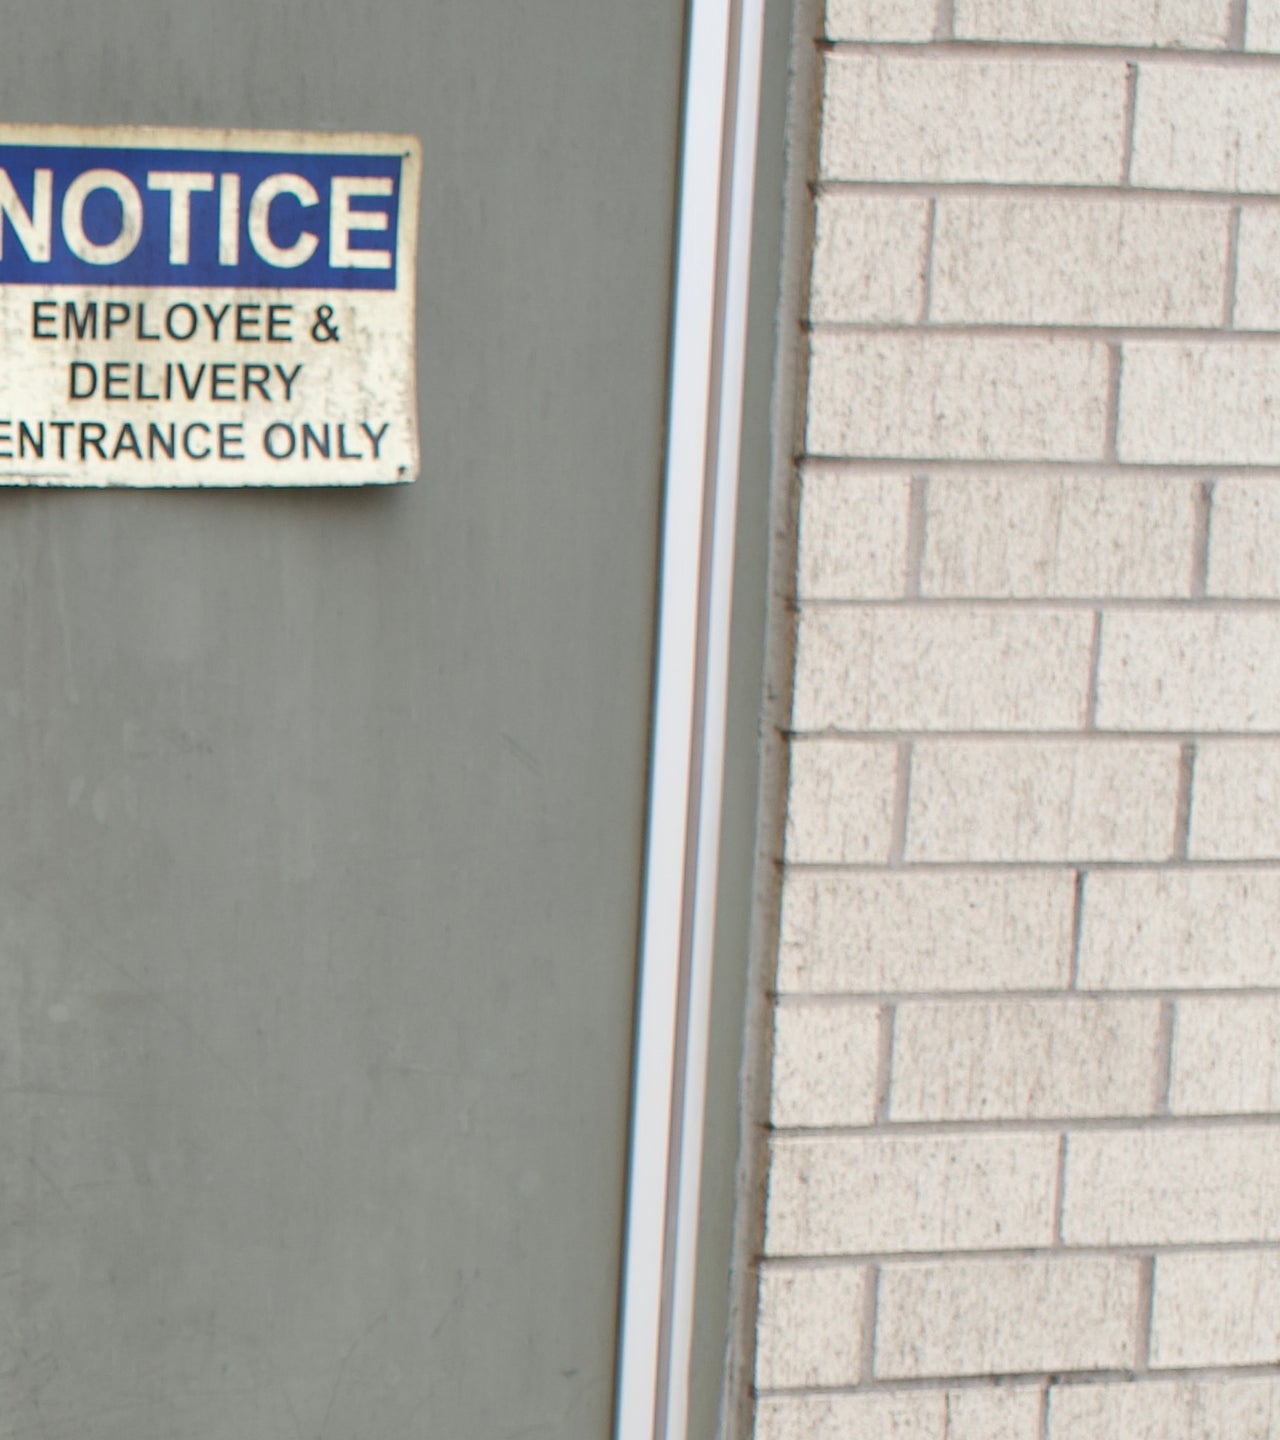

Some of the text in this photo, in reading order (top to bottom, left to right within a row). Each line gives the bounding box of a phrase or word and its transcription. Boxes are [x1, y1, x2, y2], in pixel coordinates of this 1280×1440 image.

[31, 301, 341, 343] EMPLOYEE &
[68, 361, 303, 402] DELIVERY
[263, 422, 390, 460] ONLY
